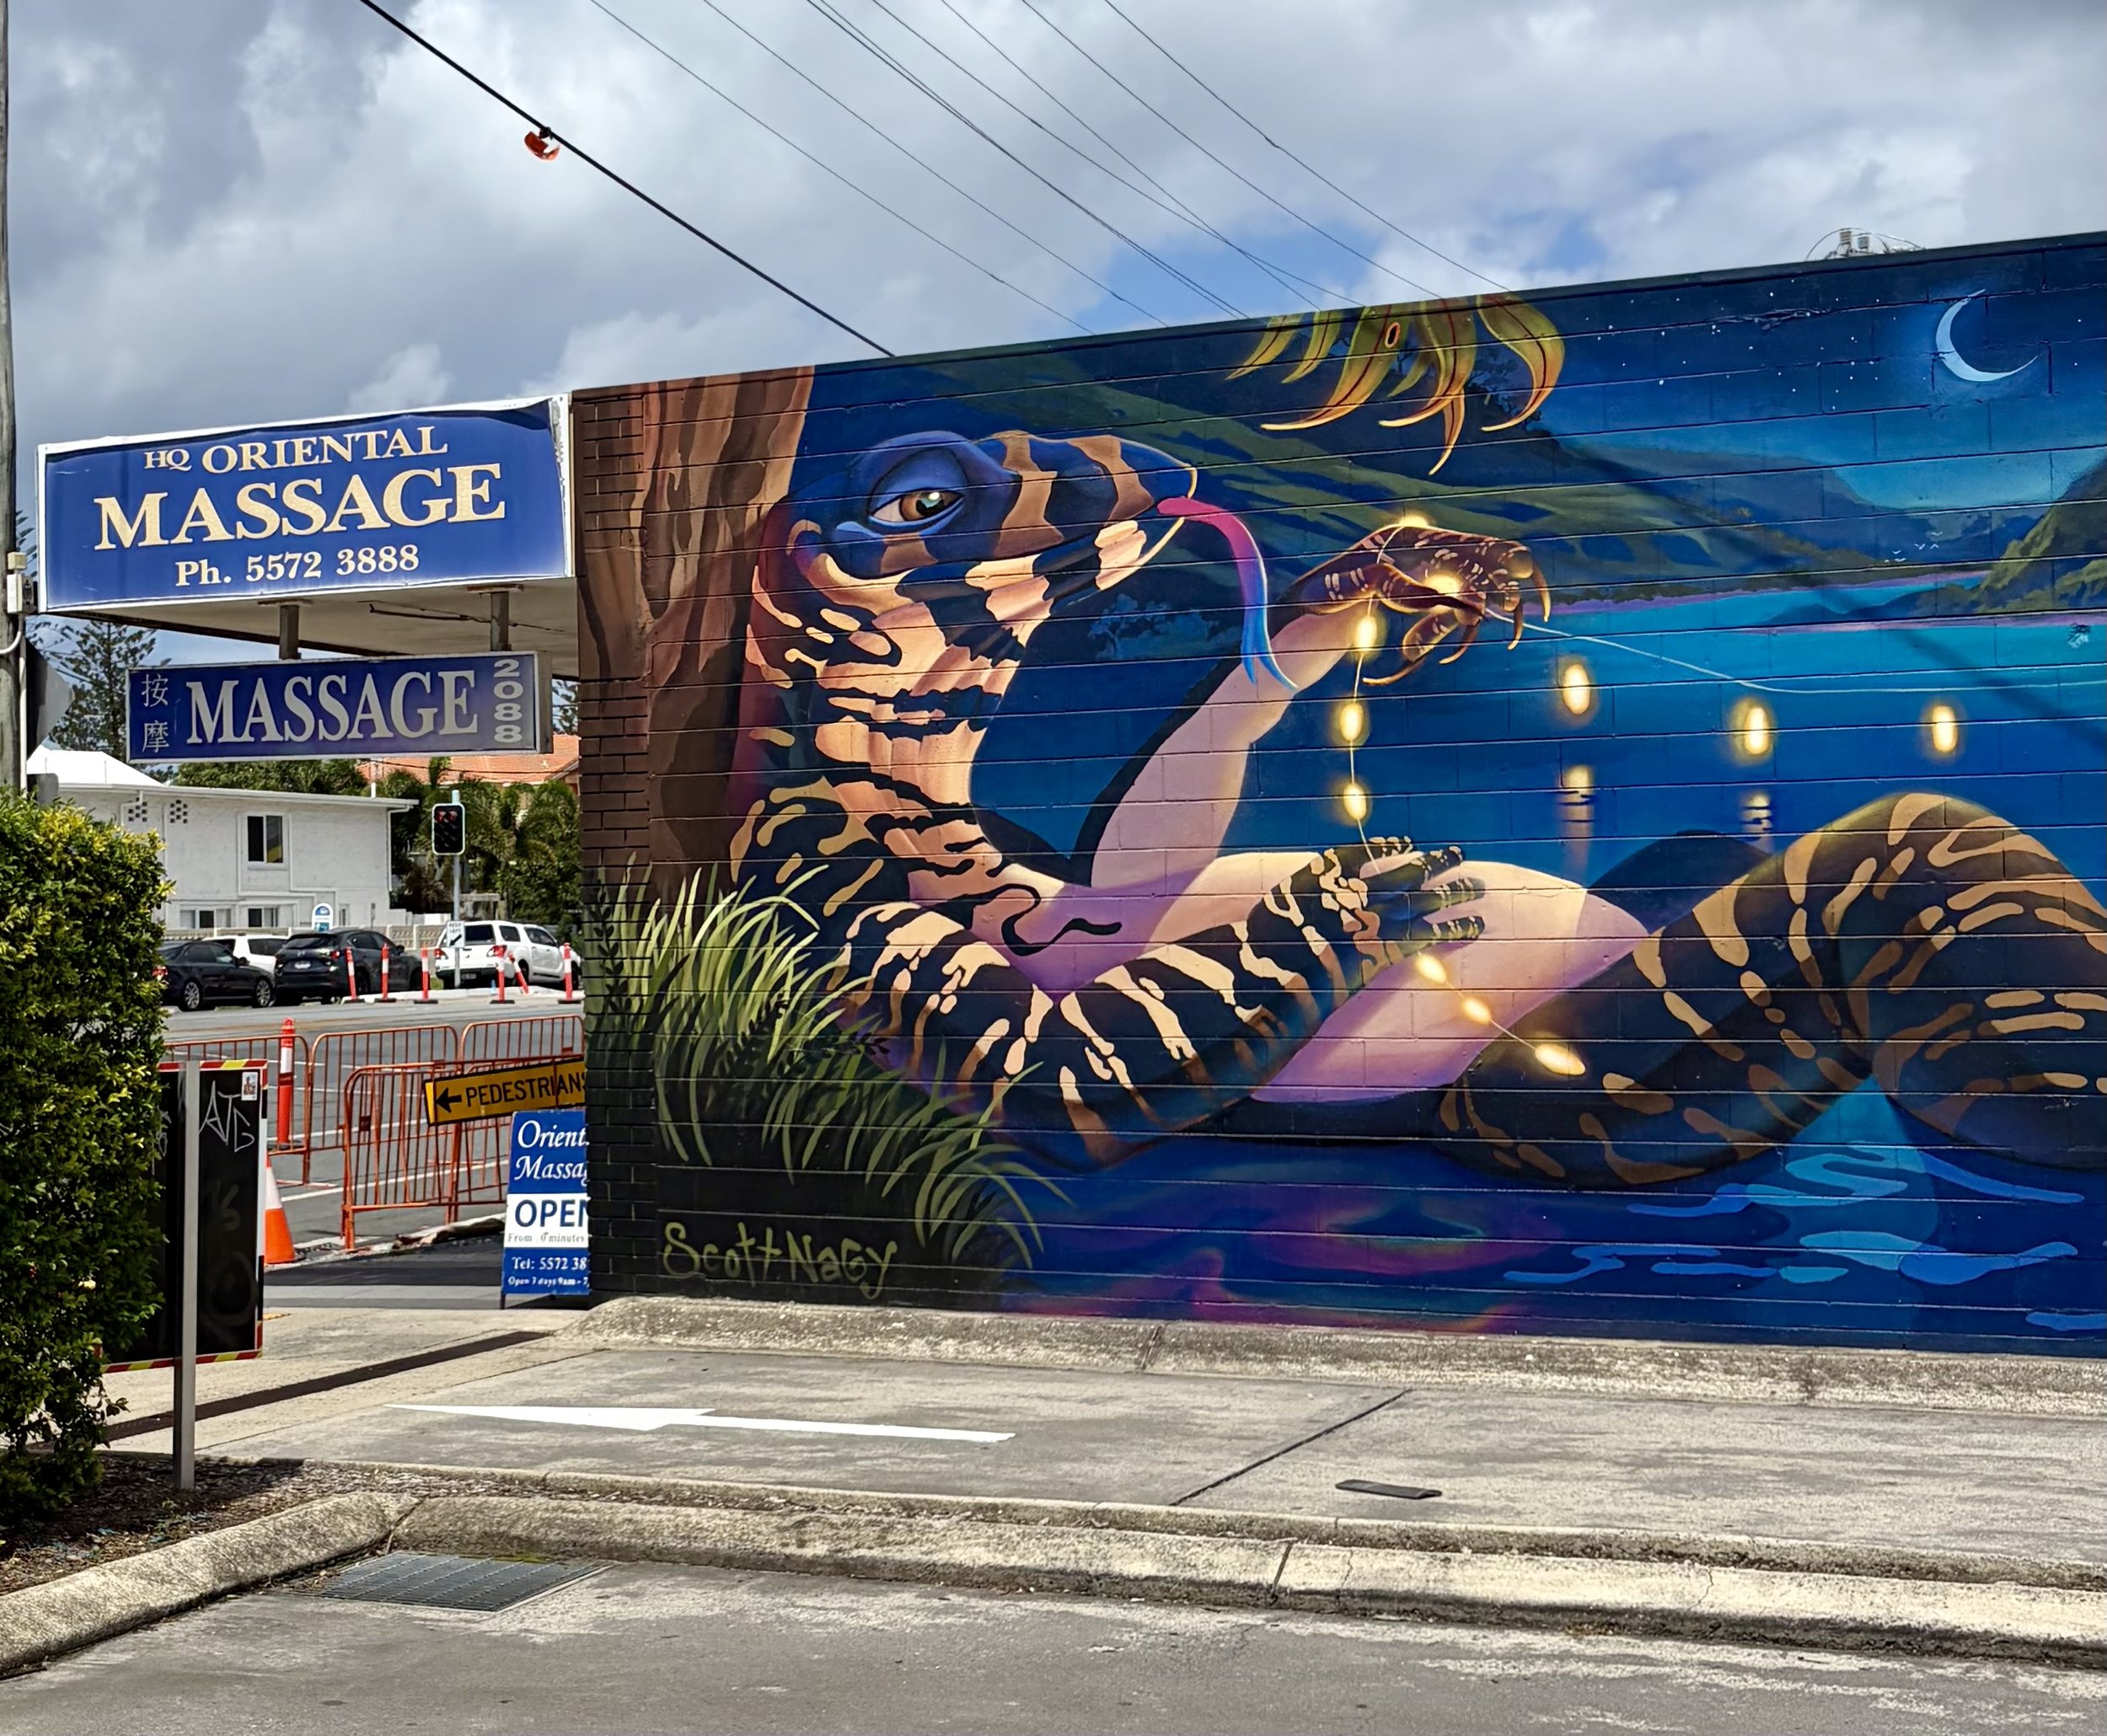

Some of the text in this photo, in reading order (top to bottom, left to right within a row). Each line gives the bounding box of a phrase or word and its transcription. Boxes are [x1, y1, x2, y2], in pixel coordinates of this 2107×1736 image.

[144, 426, 448, 474] HQ ORIENTAL
[94, 462, 506, 551] MASSAGE
[174, 544, 420, 587] Ph. 5572 3888
[141, 672, 170, 753] 按摩
[185, 669, 480, 745] MASSAGE
[493, 658, 523, 744] 2088
[507, 1233, 533, 1243] From
[511, 1256, 535, 1270] Tel:
[539, 1256, 569, 1271] 5572
[663, 1221, 783, 1289] Scott
[507, 1276, 530, 1288] Open
